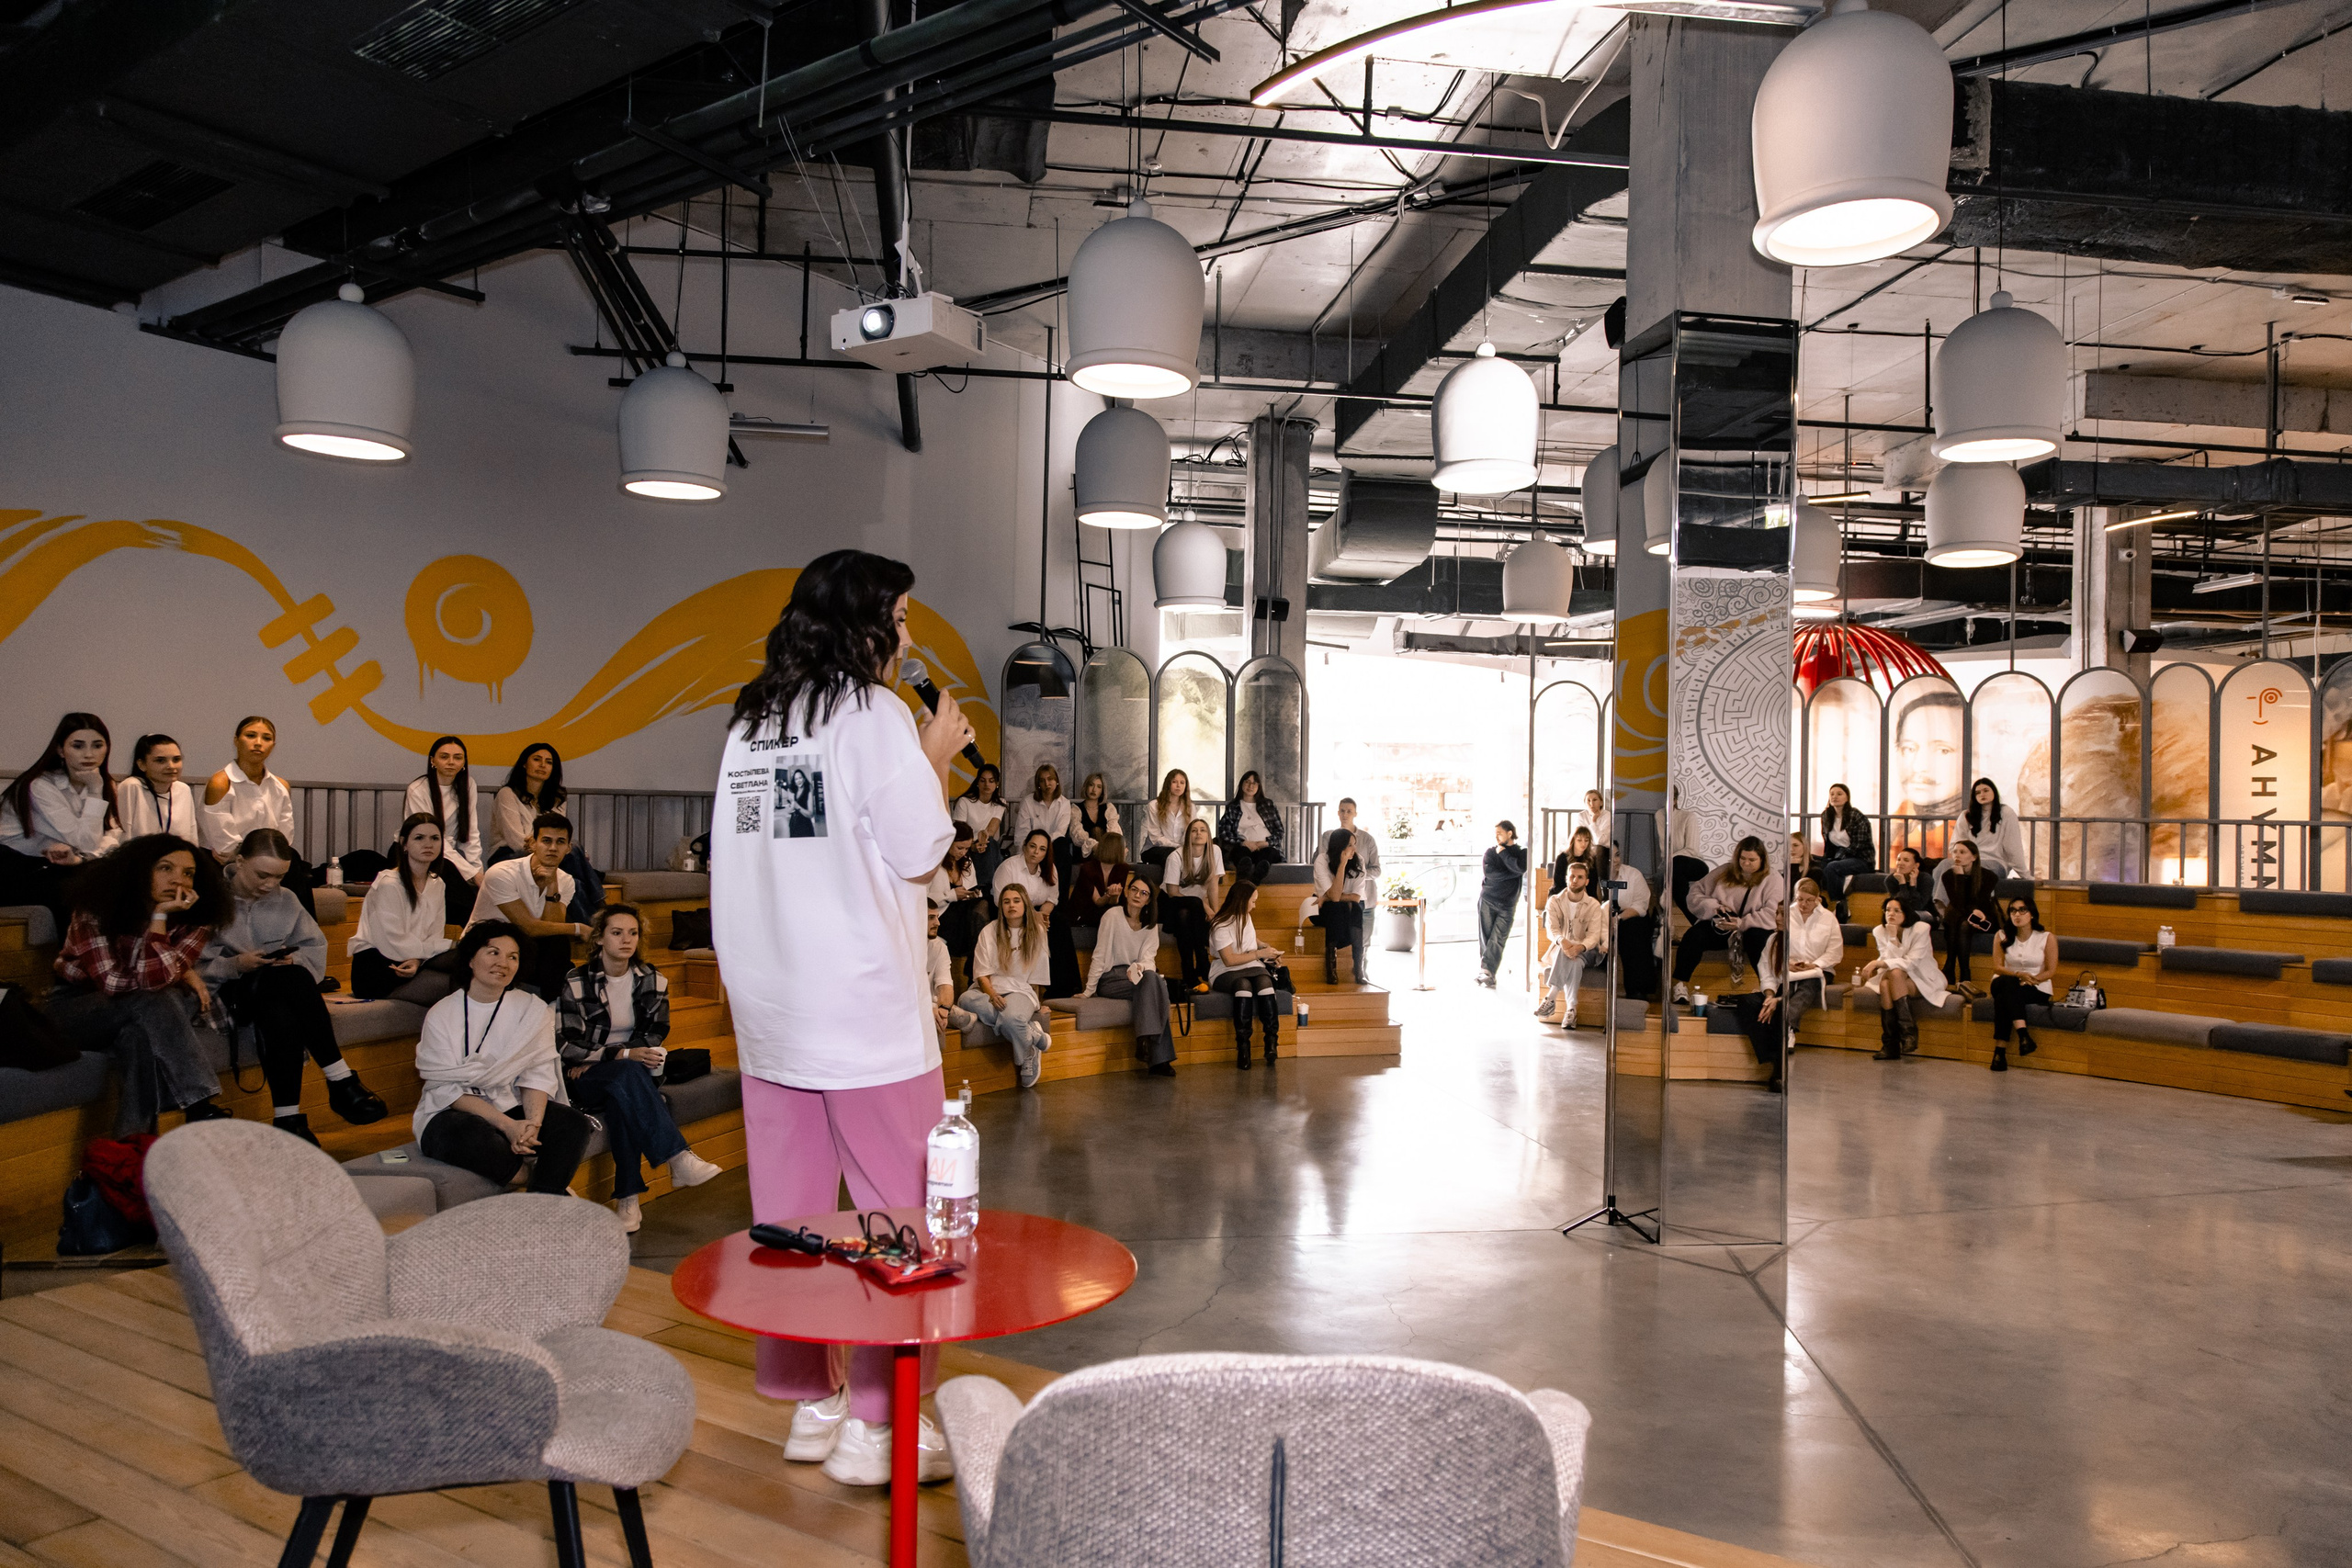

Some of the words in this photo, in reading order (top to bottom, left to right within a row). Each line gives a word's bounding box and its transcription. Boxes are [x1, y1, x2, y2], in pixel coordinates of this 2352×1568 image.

[750, 736, 799, 752] СПИКЕР
[728, 768, 770, 778] КОСТЫЛЕВА
[730, 780, 768, 789] СВЕТЛАНА
